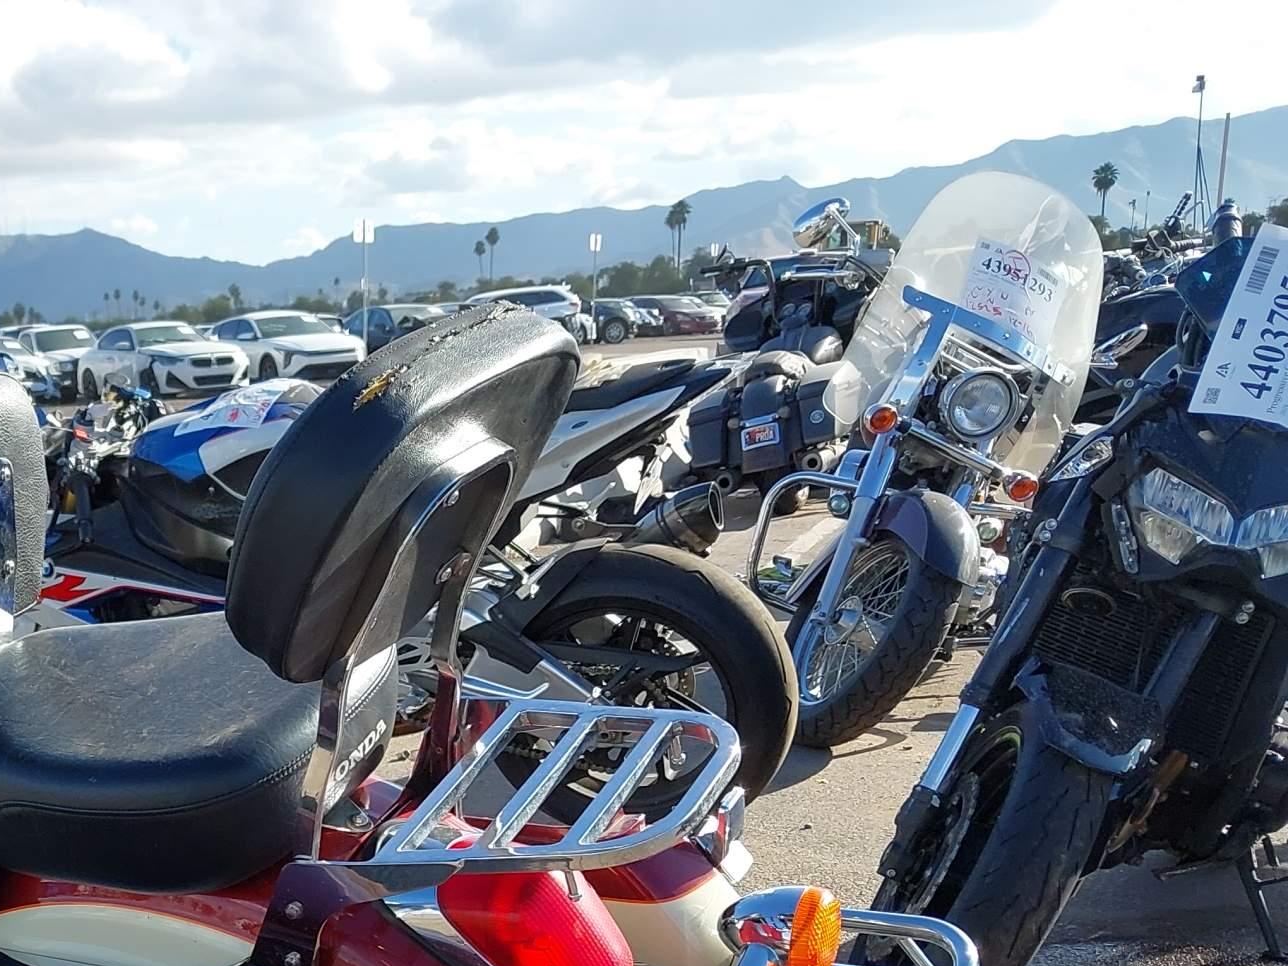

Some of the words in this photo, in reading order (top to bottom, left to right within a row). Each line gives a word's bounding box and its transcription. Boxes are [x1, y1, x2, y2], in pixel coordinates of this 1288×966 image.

[981, 256, 1053, 303] 43951293
[1239, 274, 1288, 400] 44037
[335, 719, 387, 781] ONDA
